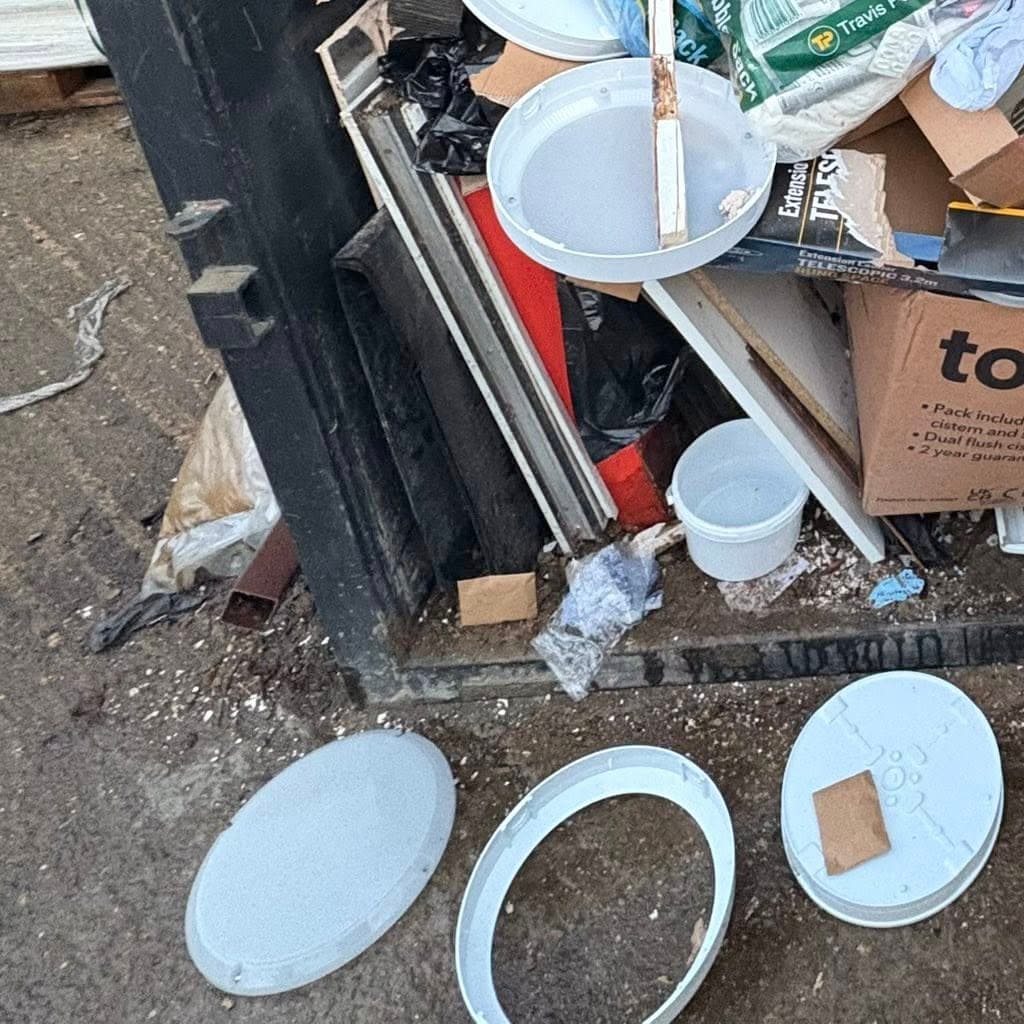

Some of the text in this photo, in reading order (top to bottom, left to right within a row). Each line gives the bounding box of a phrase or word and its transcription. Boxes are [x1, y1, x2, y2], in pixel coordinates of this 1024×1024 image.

[838, 7, 888, 37] Travis
[673, 26, 709, 65] ack
[811, 31, 836, 53] TP
[778, 160, 809, 219] Extensio
[799, 249, 857, 266] Extension
[900, 275, 939, 287] 3.2m
[933, 403, 972, 420] Pack
[930, 420, 983, 434] cistern
[986, 427, 1017, 439] and
[923, 432, 963, 445] Dual
[966, 436, 1003, 450] flush
[918, 445, 931, 455] 2
[933, 449, 968, 459] year
